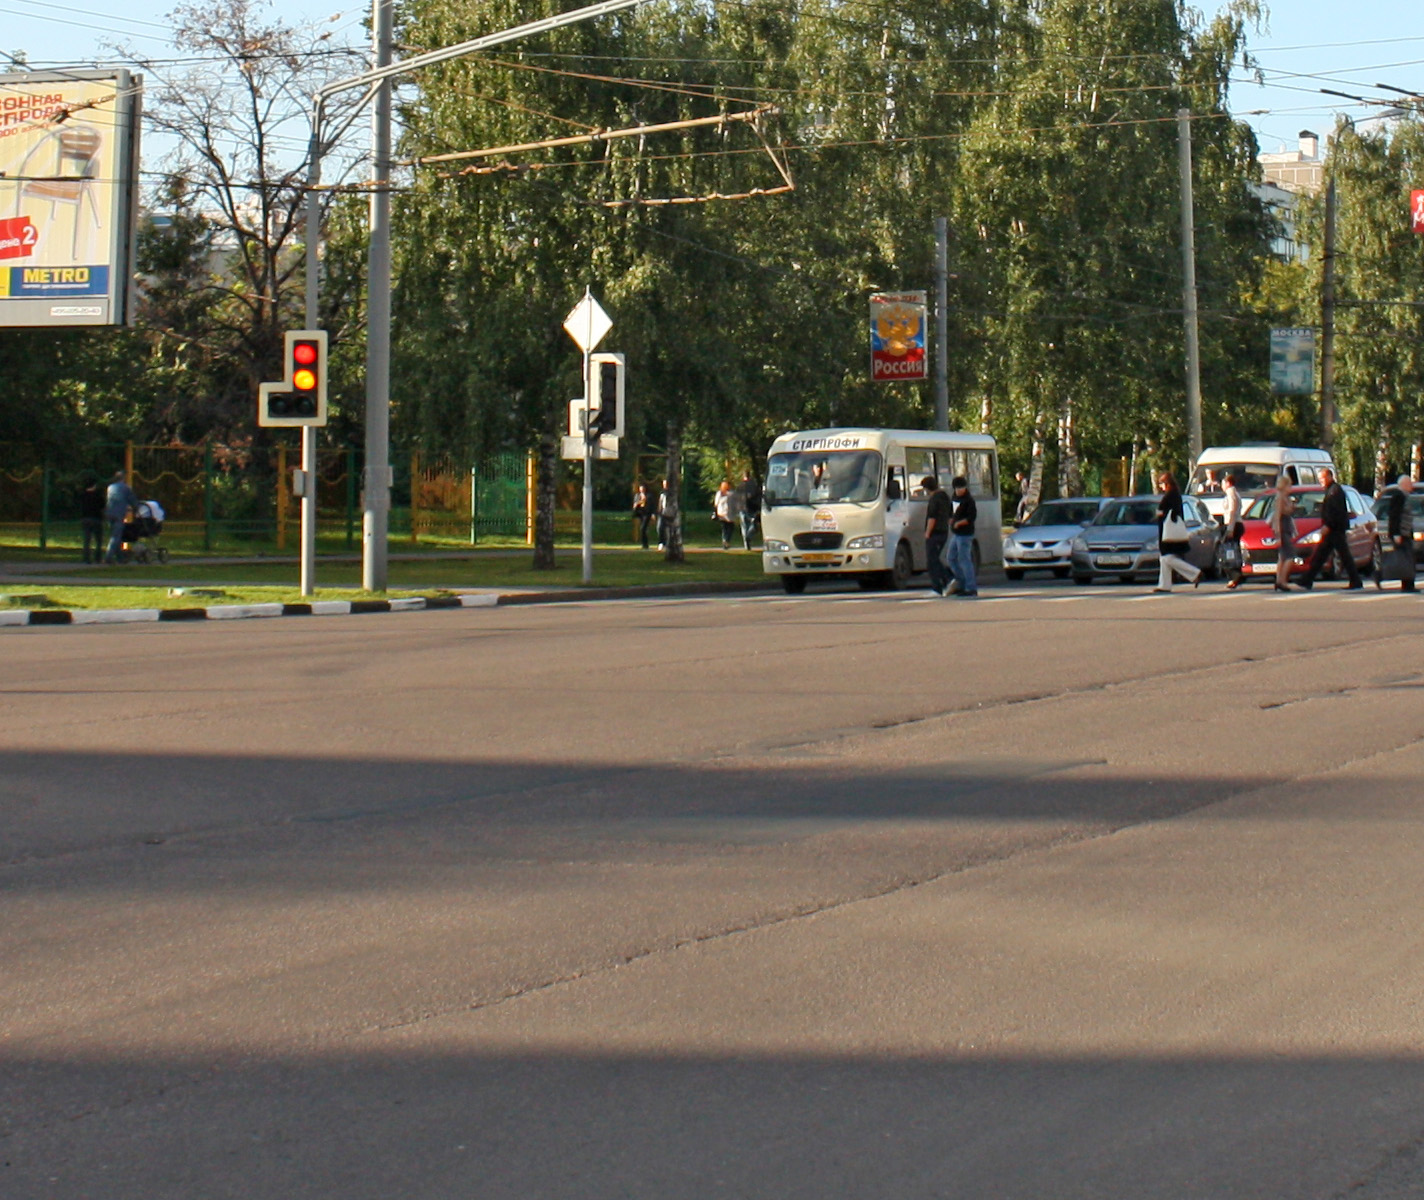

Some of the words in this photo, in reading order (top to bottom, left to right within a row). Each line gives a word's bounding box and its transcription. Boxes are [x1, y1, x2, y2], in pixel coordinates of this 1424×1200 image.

[22, 225, 36, 246] 2
[22, 267, 90, 284] METRO
[792, 438, 861, 451] СТАРПРОФИ
